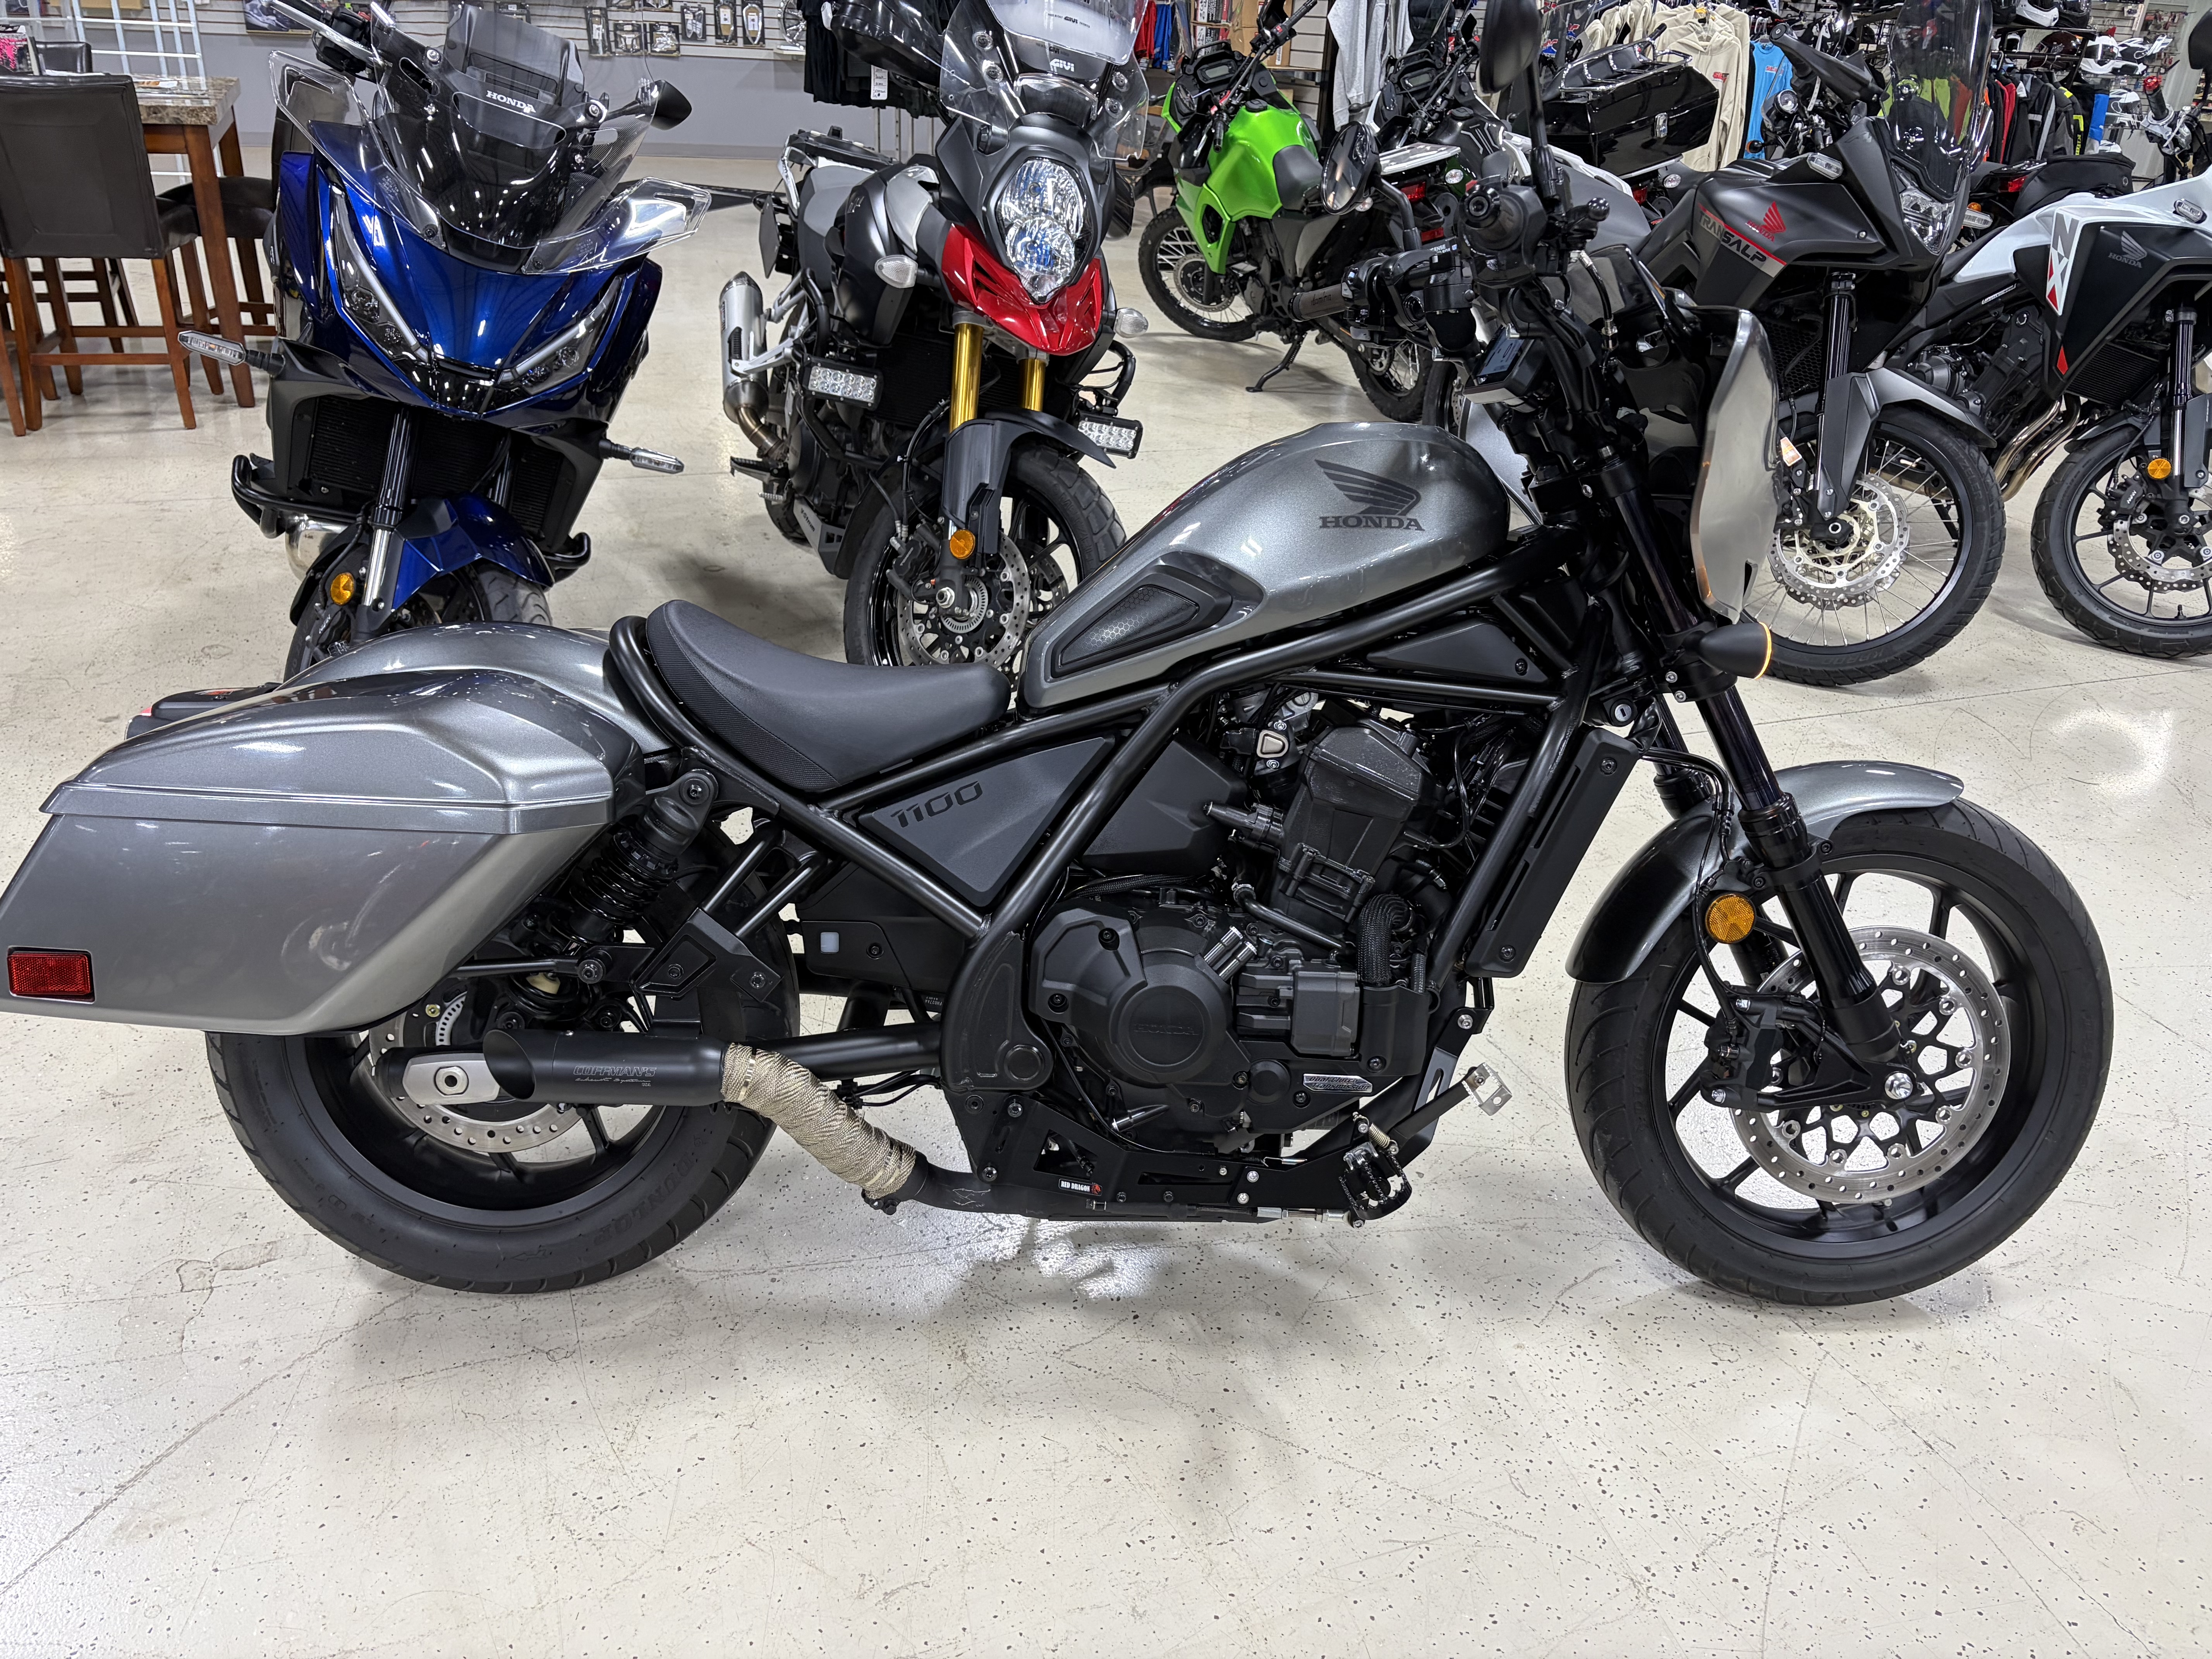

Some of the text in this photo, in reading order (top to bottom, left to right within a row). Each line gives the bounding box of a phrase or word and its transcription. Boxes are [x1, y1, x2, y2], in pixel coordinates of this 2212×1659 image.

[1064, 16, 1078, 24] GIVI
[1049, 58, 1075, 72] GIVI
[486, 90, 536, 113] HONDA
[1698, 212, 1767, 264] TRANSALP
[1747, 219, 1775, 242] HONDA
[2107, 252, 2143, 269] HONDA
[1939, 436, 1983, 500] METZELER
[1319, 515, 1425, 532] HONDA
[891, 780, 983, 828] 1100
[1133, 1023, 1200, 1036] HONDA
[573, 1065, 657, 1077] COFFMAN'S
[1071, 1183, 1090, 1192] DRAGON
[593, 1152, 696, 1246] DUNLOP
